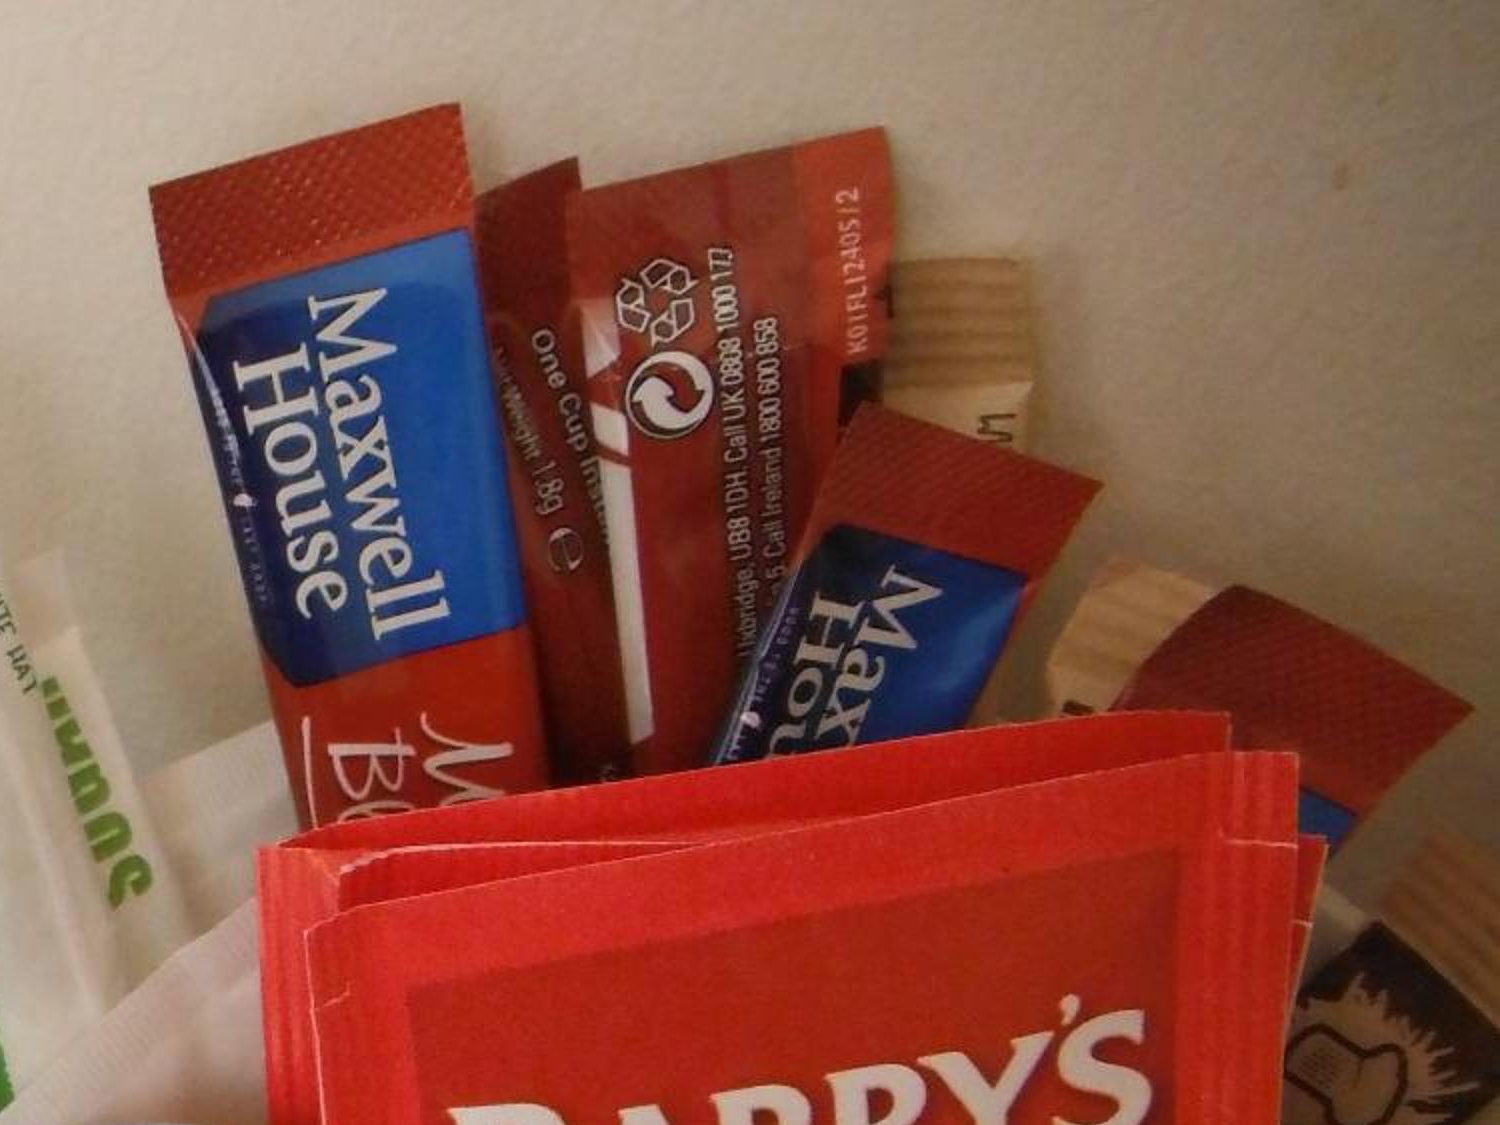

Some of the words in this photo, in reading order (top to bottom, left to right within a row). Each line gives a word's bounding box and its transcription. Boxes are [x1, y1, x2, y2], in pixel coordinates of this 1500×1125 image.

[711, 285, 740, 332] 1000
[717, 336, 745, 386] 0808
[756, 357, 782, 395] 600
[531, 328, 566, 390] One
[558, 393, 589, 452] Cup
[721, 388, 747, 421] UK
[723, 424, 749, 463] Call
[758, 398, 783, 443] 1800
[234, 347, 348, 620] House
[308, 287, 451, 641] Maxwell
[759, 447, 784, 518] Ireland
[813, 563, 944, 748] Max
